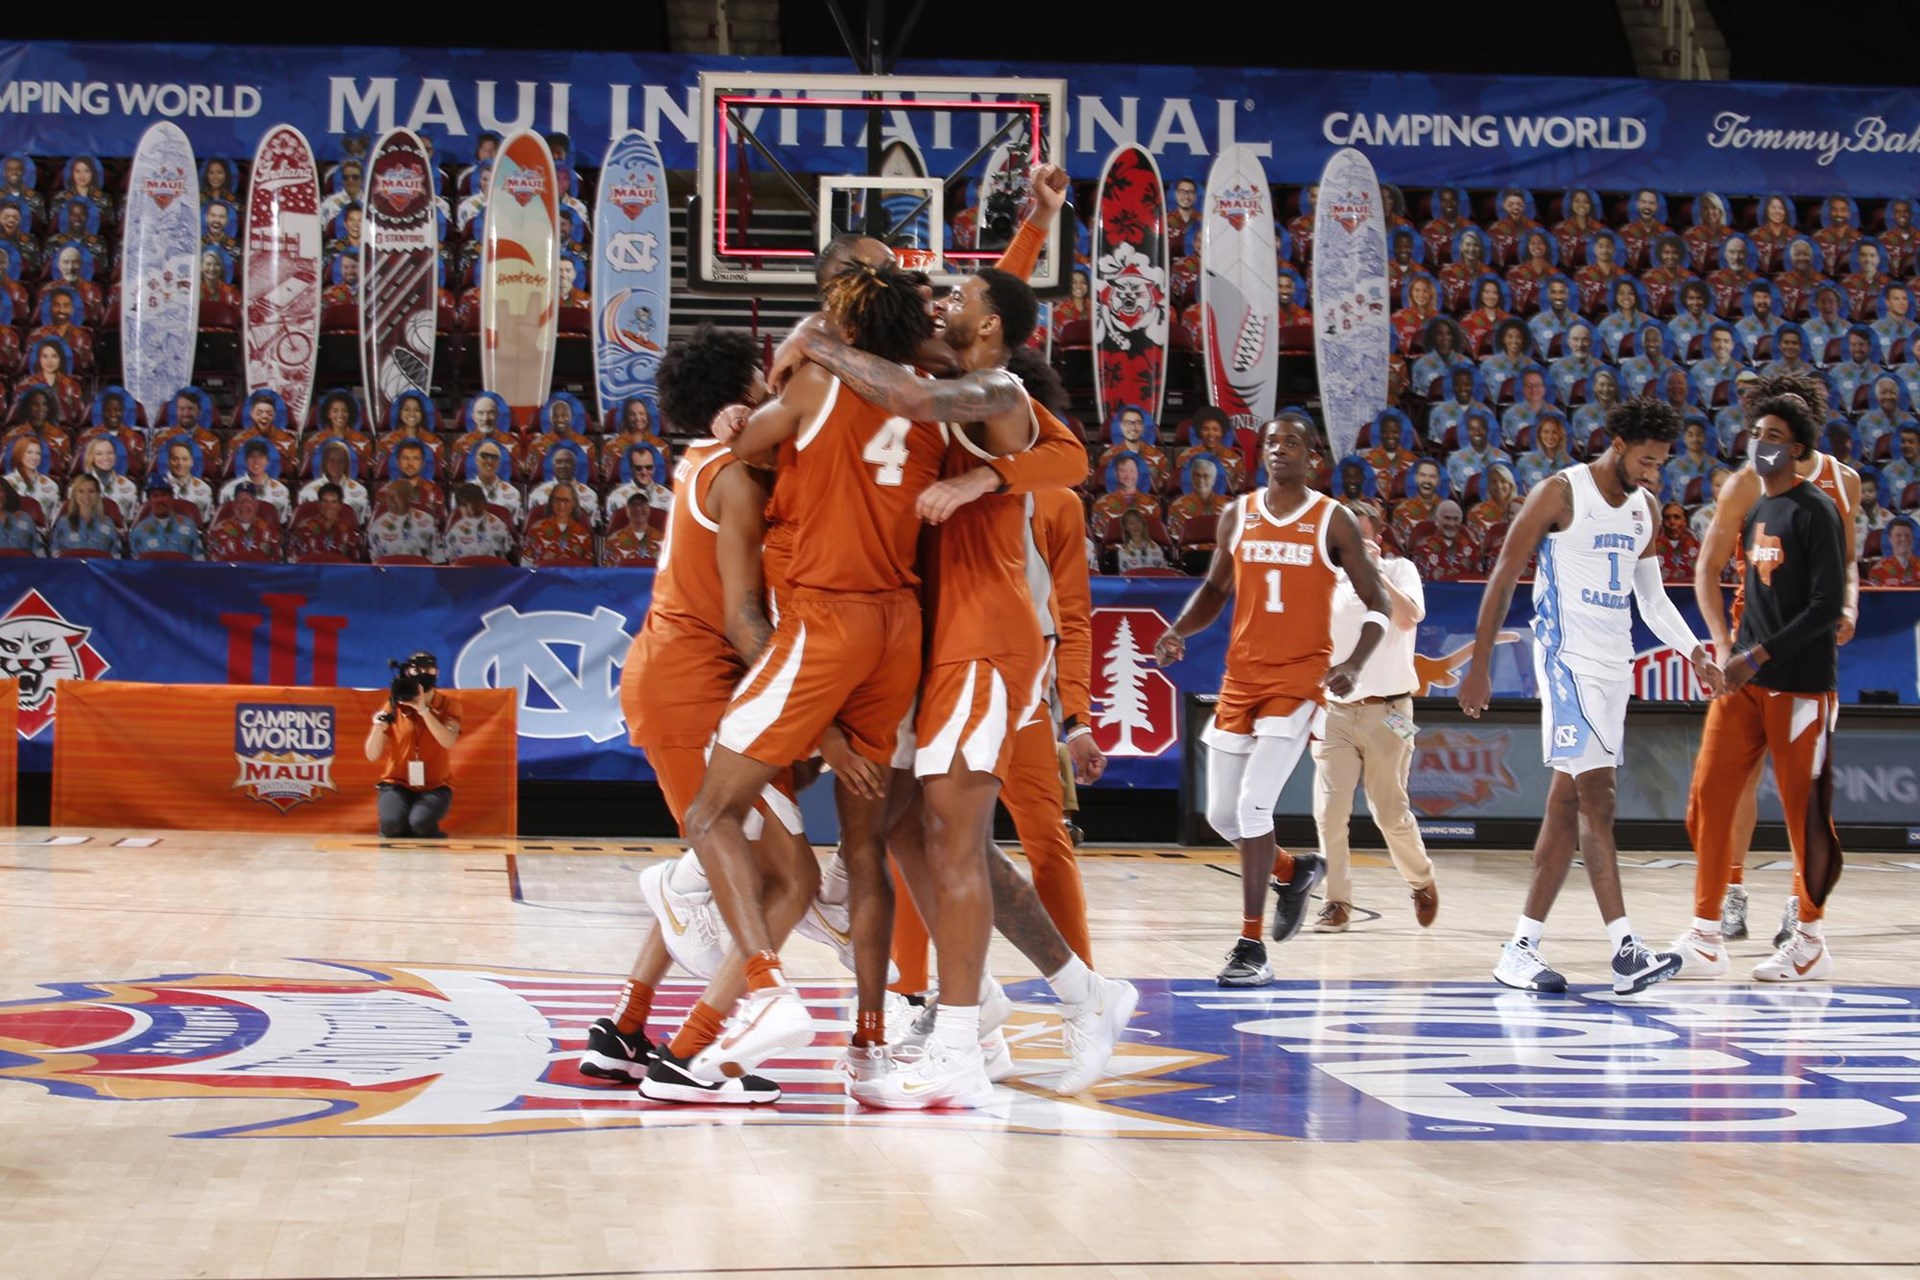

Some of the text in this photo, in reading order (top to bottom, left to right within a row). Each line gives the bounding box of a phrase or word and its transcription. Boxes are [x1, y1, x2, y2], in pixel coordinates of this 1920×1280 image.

[116, 83, 262, 117] WORLD
[328, 76, 572, 137] MAUI
[1322, 112, 1647, 149] CAMPING WORLD
[1707, 111, 1850, 166] Tommy
[256, 160, 312, 182] Indiana
[146, 181, 182, 190] MAUI
[382, 180, 419, 189] MAUI
[507, 179, 542, 188] MAUI
[614, 188, 653, 198] MAUI
[1219, 200, 1258, 209] MAUI
[1333, 205, 1369, 214] MAUI
[385, 234, 424, 243] STANFORD
[712, 271, 749, 282] SPALDING
[862, 417, 911, 486] 4
[1242, 540, 1314, 567] TEXAS
[1593, 533, 1636, 552] NORTH
[1607, 552, 1621, 591] 1
[1264, 568, 1285, 613] 1
[240, 709, 331, 730] CAMPING
[241, 727, 331, 750] WORLD
[246, 761, 324, 783] MAUI
[1418, 749, 1495, 774] AUI
[1448, 827, 1475, 835] WORLD
